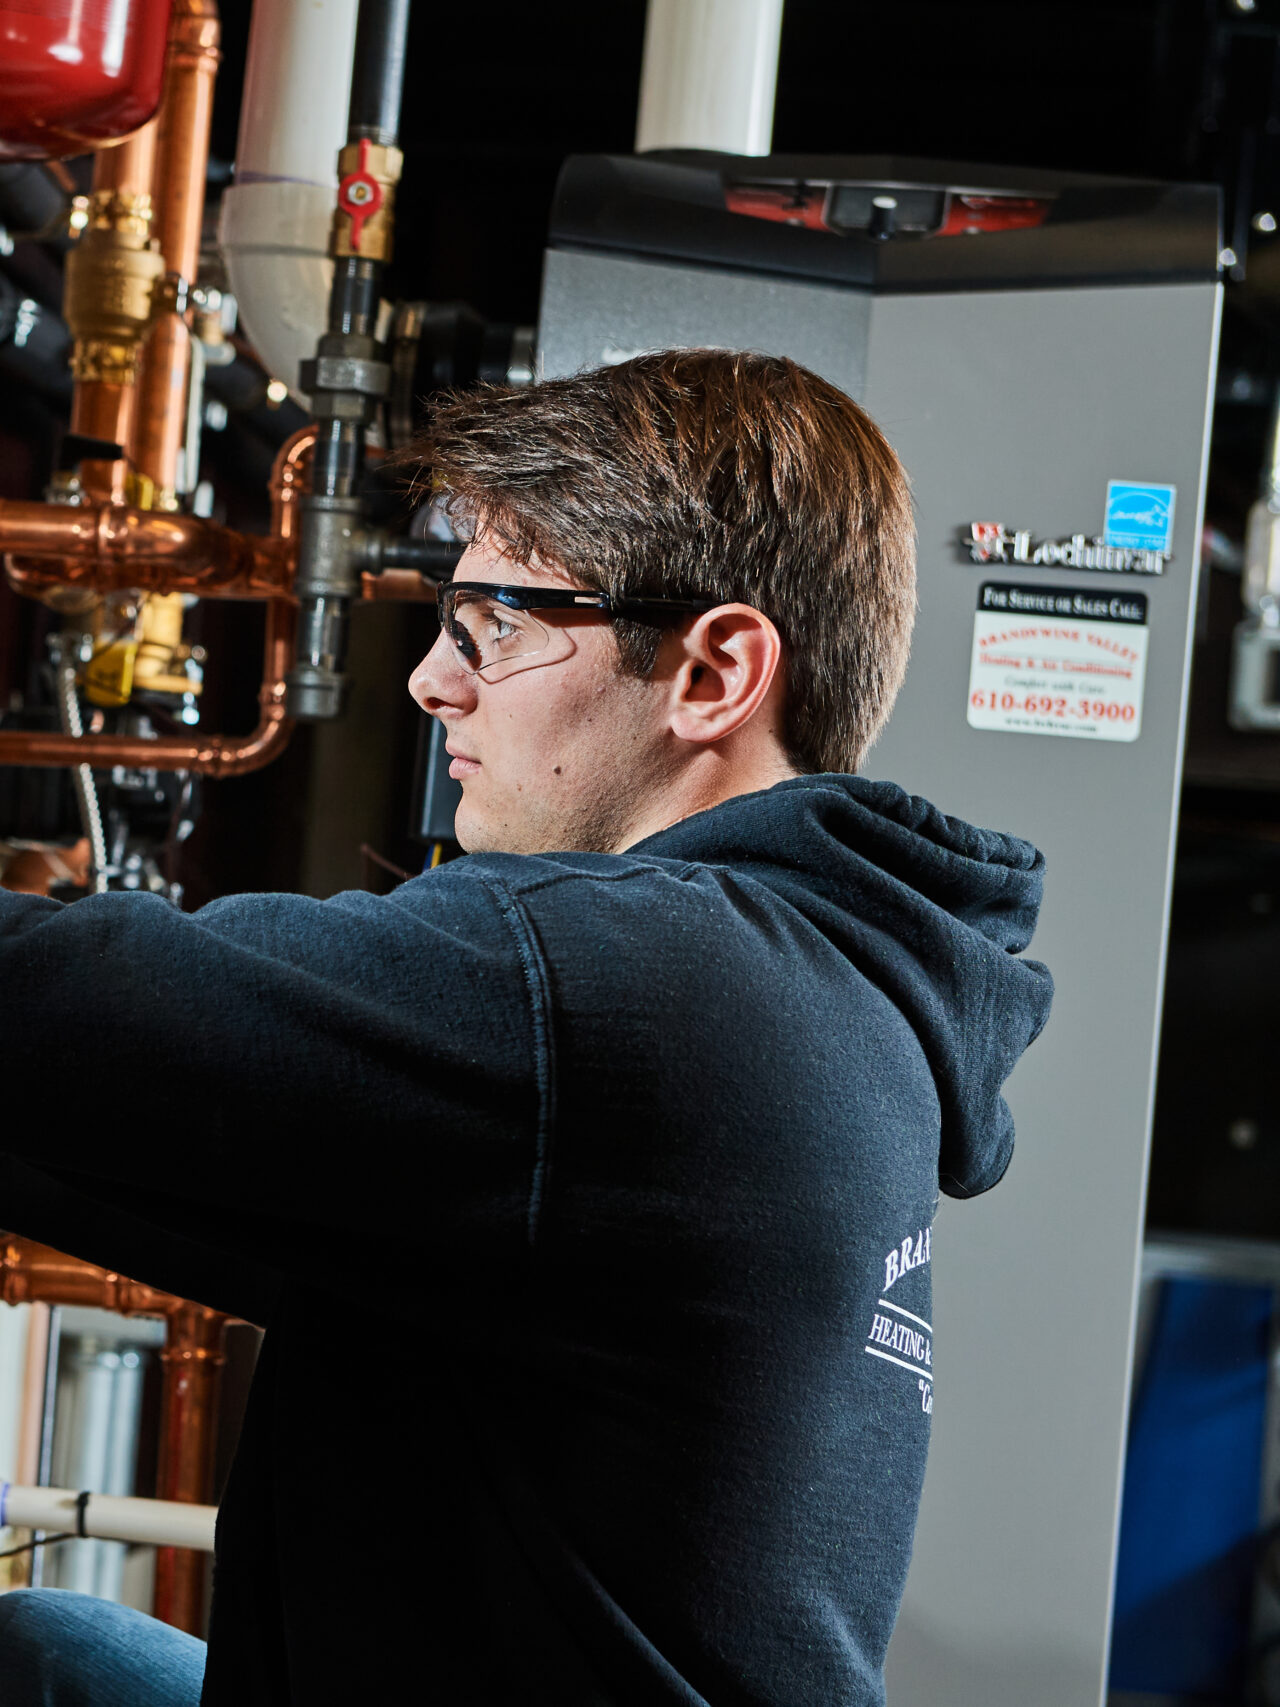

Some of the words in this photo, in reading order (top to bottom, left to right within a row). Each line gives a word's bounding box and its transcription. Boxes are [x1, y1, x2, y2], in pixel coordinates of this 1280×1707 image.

[983, 587, 1007, 607] FOR
[1009, 589, 1055, 612] SERVICE
[1073, 594, 1108, 617] SALES
[978, 626, 1081, 648] BRANDYWINE
[1086, 632, 1139, 664] VALLEY
[979, 652, 1022, 669] Heating
[1062, 660, 1133, 680] Conditioning
[970, 689, 1136, 724] 610-692-3900
[868, 1313, 925, 1361] HEATING
